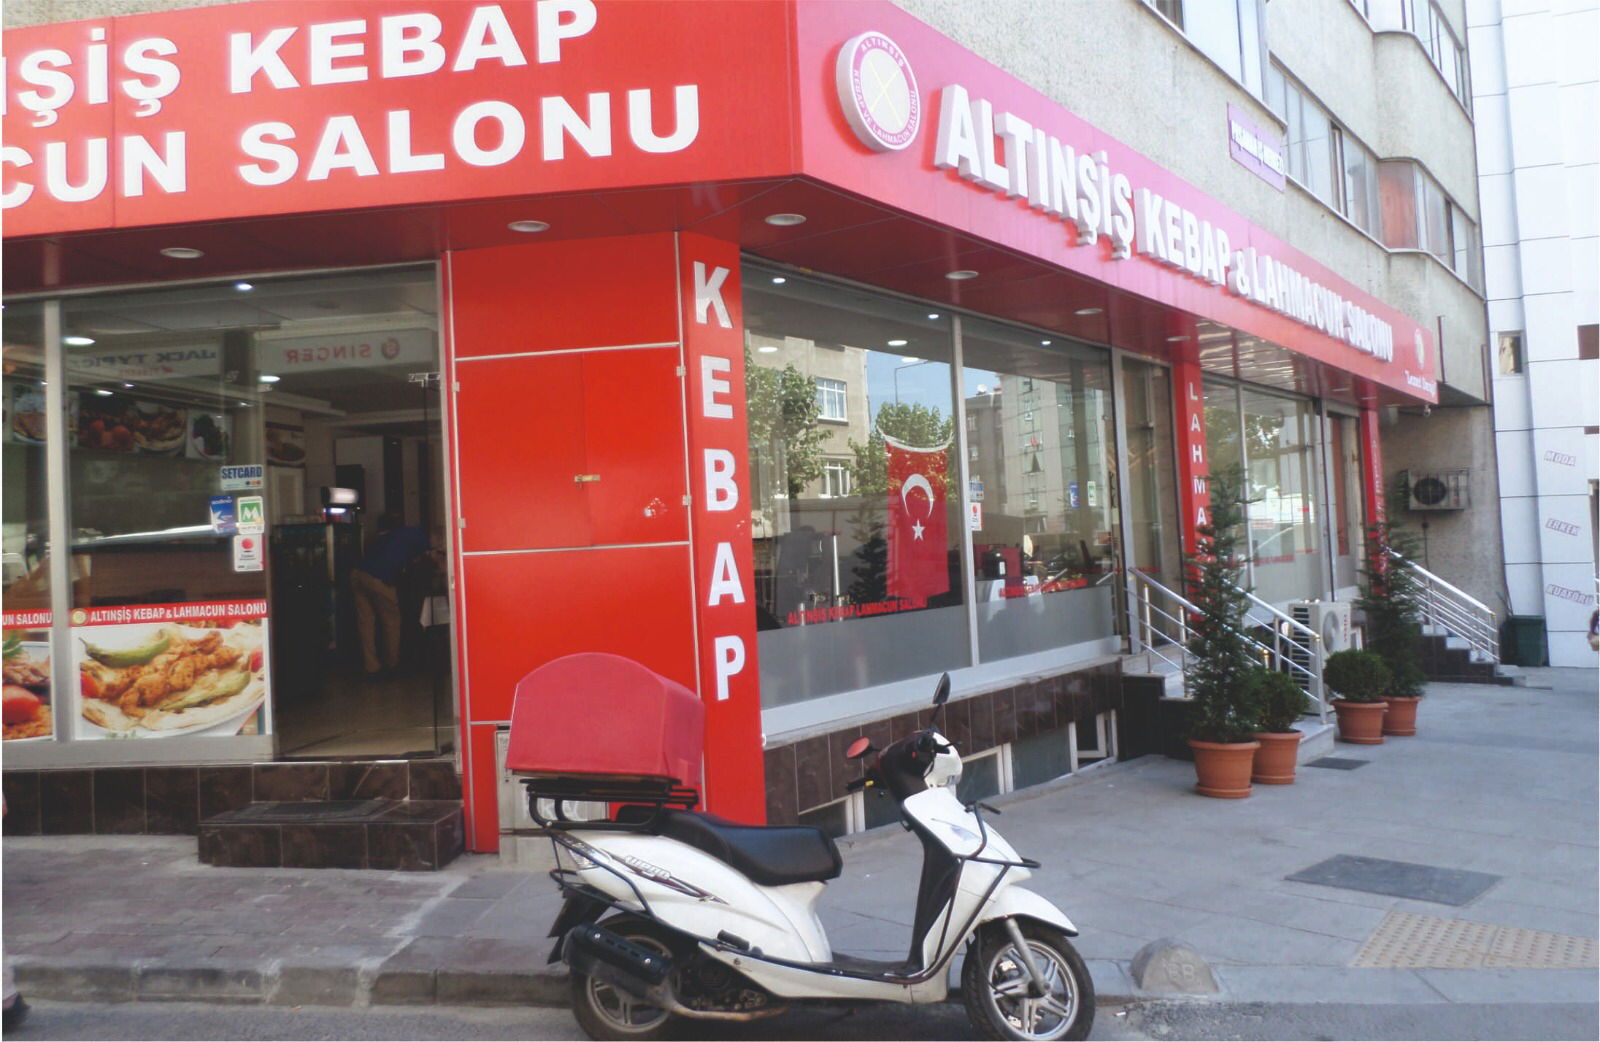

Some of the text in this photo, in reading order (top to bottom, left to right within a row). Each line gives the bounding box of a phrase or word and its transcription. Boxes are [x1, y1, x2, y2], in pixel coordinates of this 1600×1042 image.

[2, 0, 598, 128] ŞİŞ KEBAP
[238, 84, 699, 186] SALONU
[934, 84, 1135, 260] ALTINŞİŞ
[1133, 187, 1230, 287] KEBAP
[1228, 249, 1251, 297] &
[1246, 247, 1346, 341] LAHMACUN
[222, 466, 262, 480] SETCARD
[693, 261, 746, 701] KEBAP
[1189, 382, 1209, 549] LAHMA
[1543, 450, 1577, 467] MODA
[1545, 517, 1581, 537] ERKEK
[16, 612, 52, 625] SALONU
[91, 602, 267, 624] ALTINŞİŞ KEBAP & LAHMACUN SALONU
